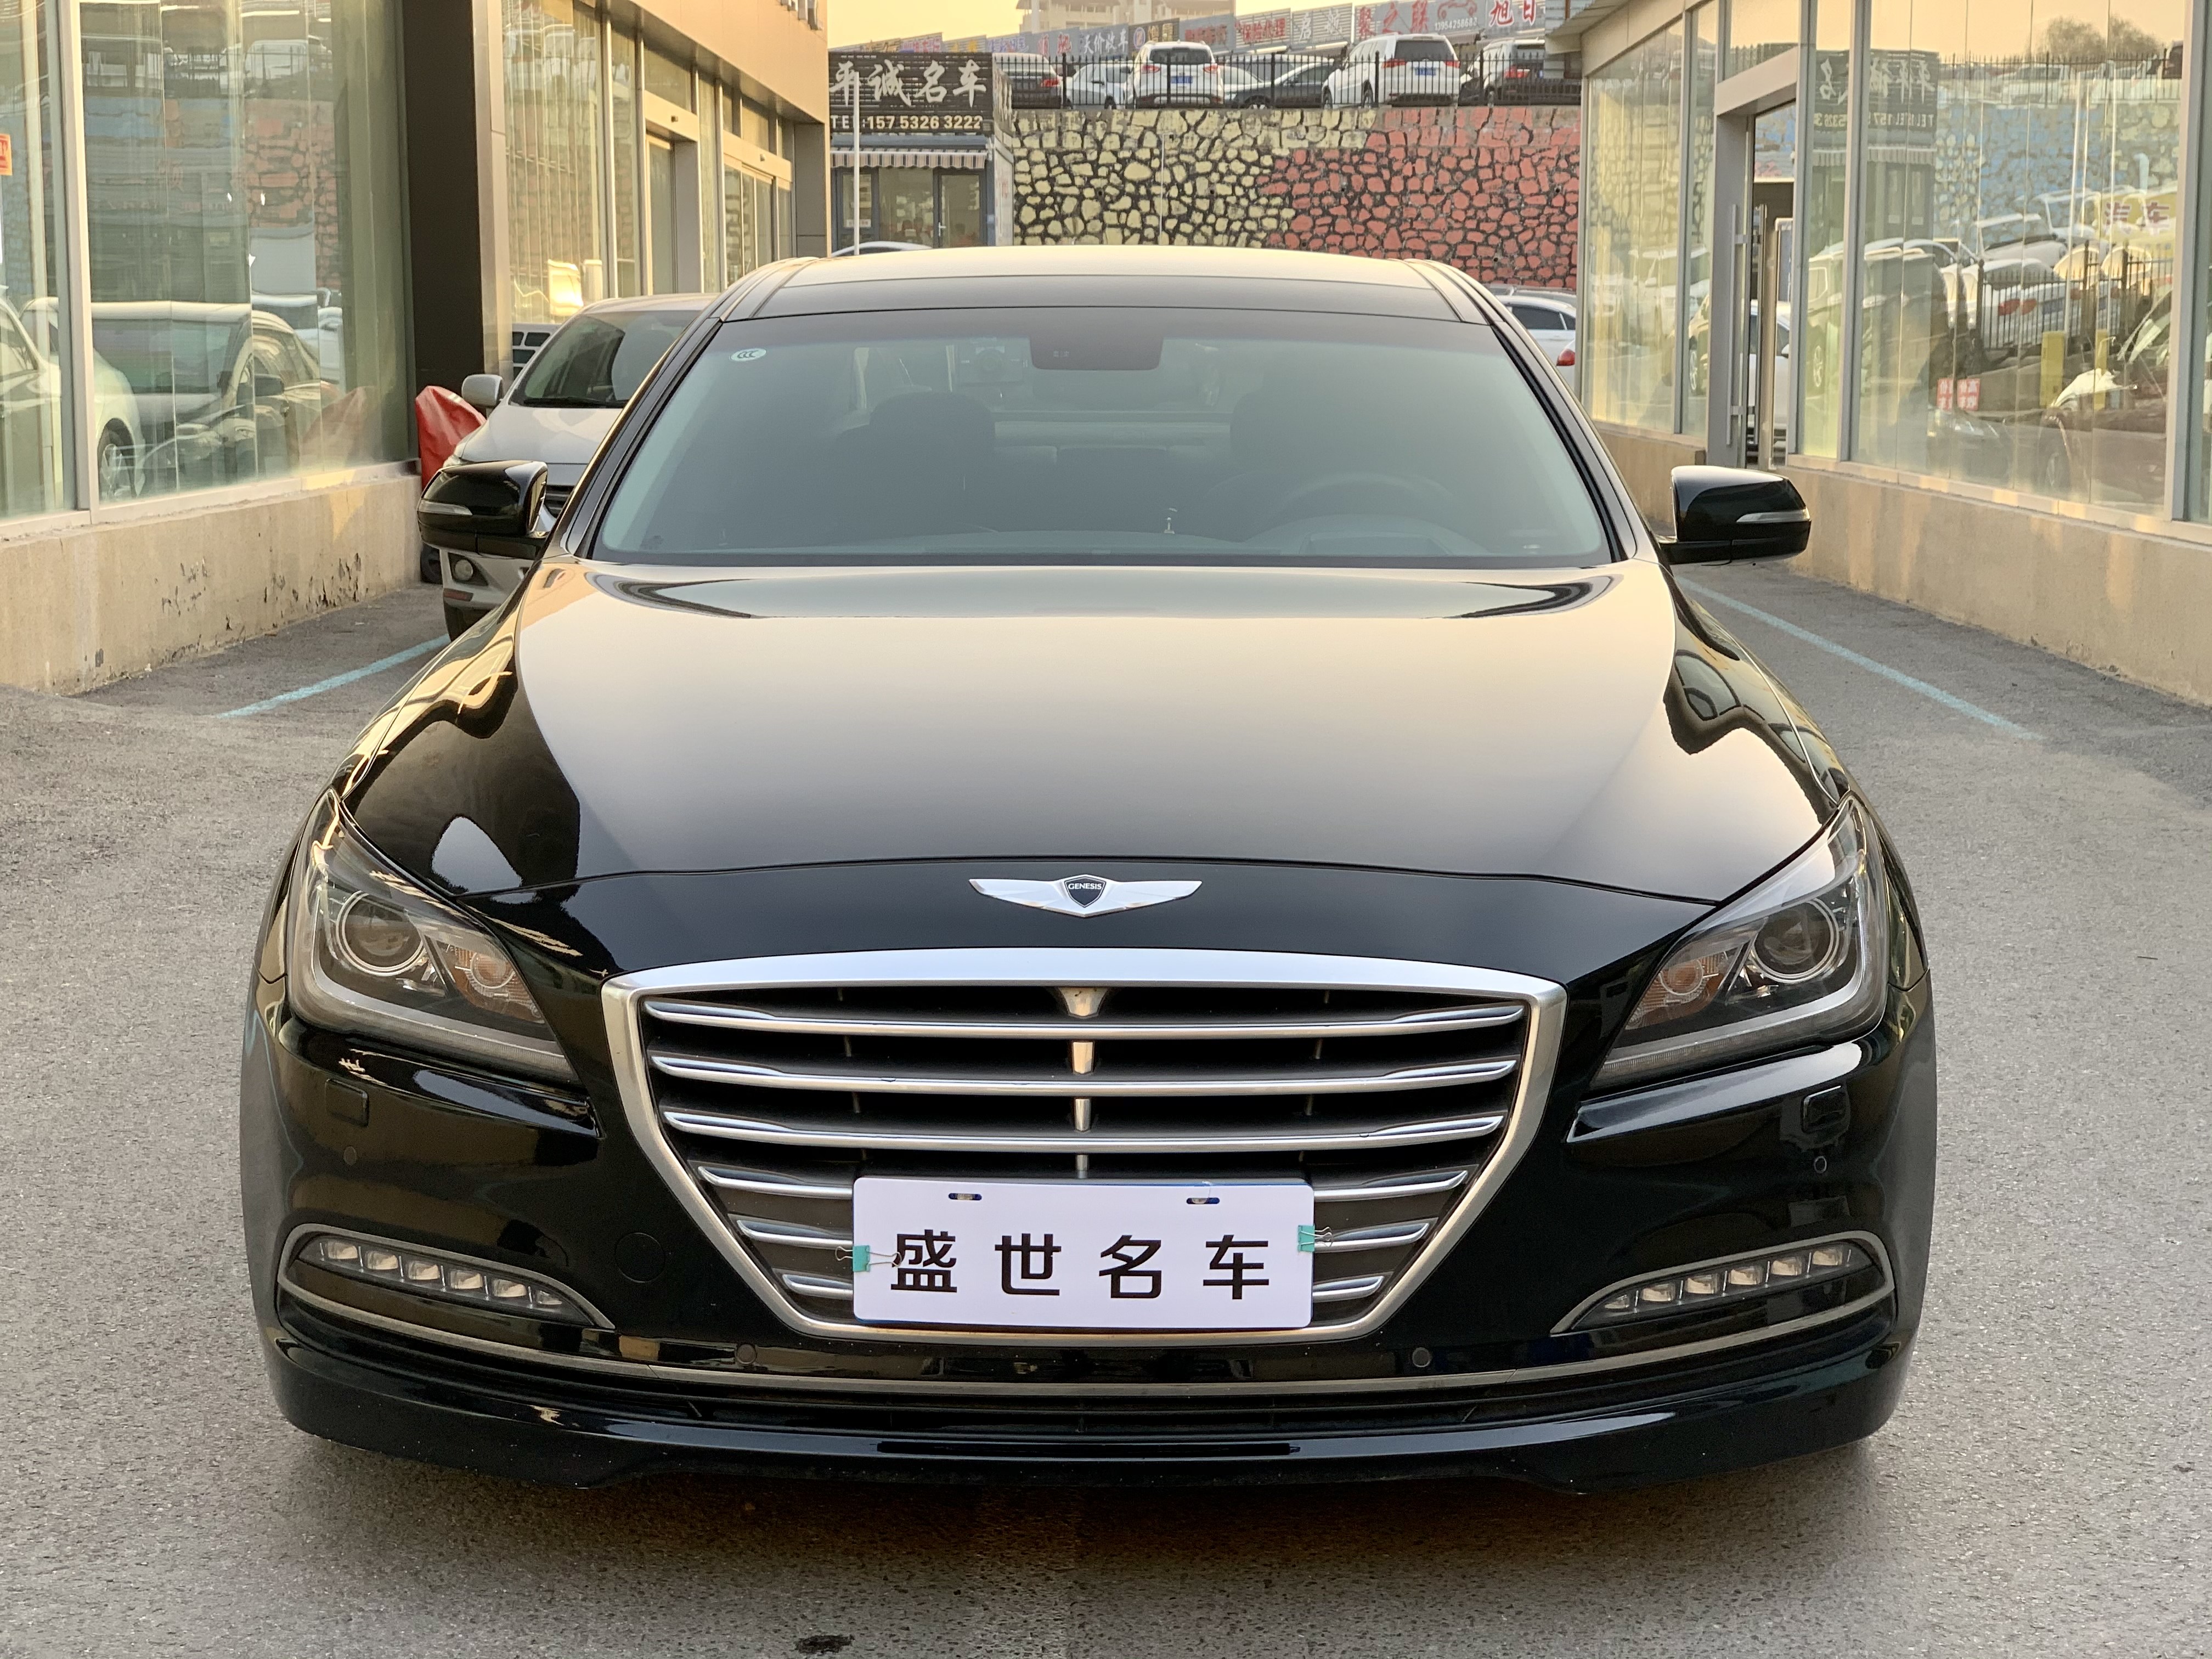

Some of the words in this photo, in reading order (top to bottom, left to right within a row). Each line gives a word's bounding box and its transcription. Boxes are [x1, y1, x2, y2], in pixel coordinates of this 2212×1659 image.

[867, 115, 895, 129] 157
[900, 115, 939, 129] 5326
[944, 115, 983, 129] 3222
[1068, 882, 1102, 891] GENESIS
[890, 1229, 1269, 1300] 盛世名车
